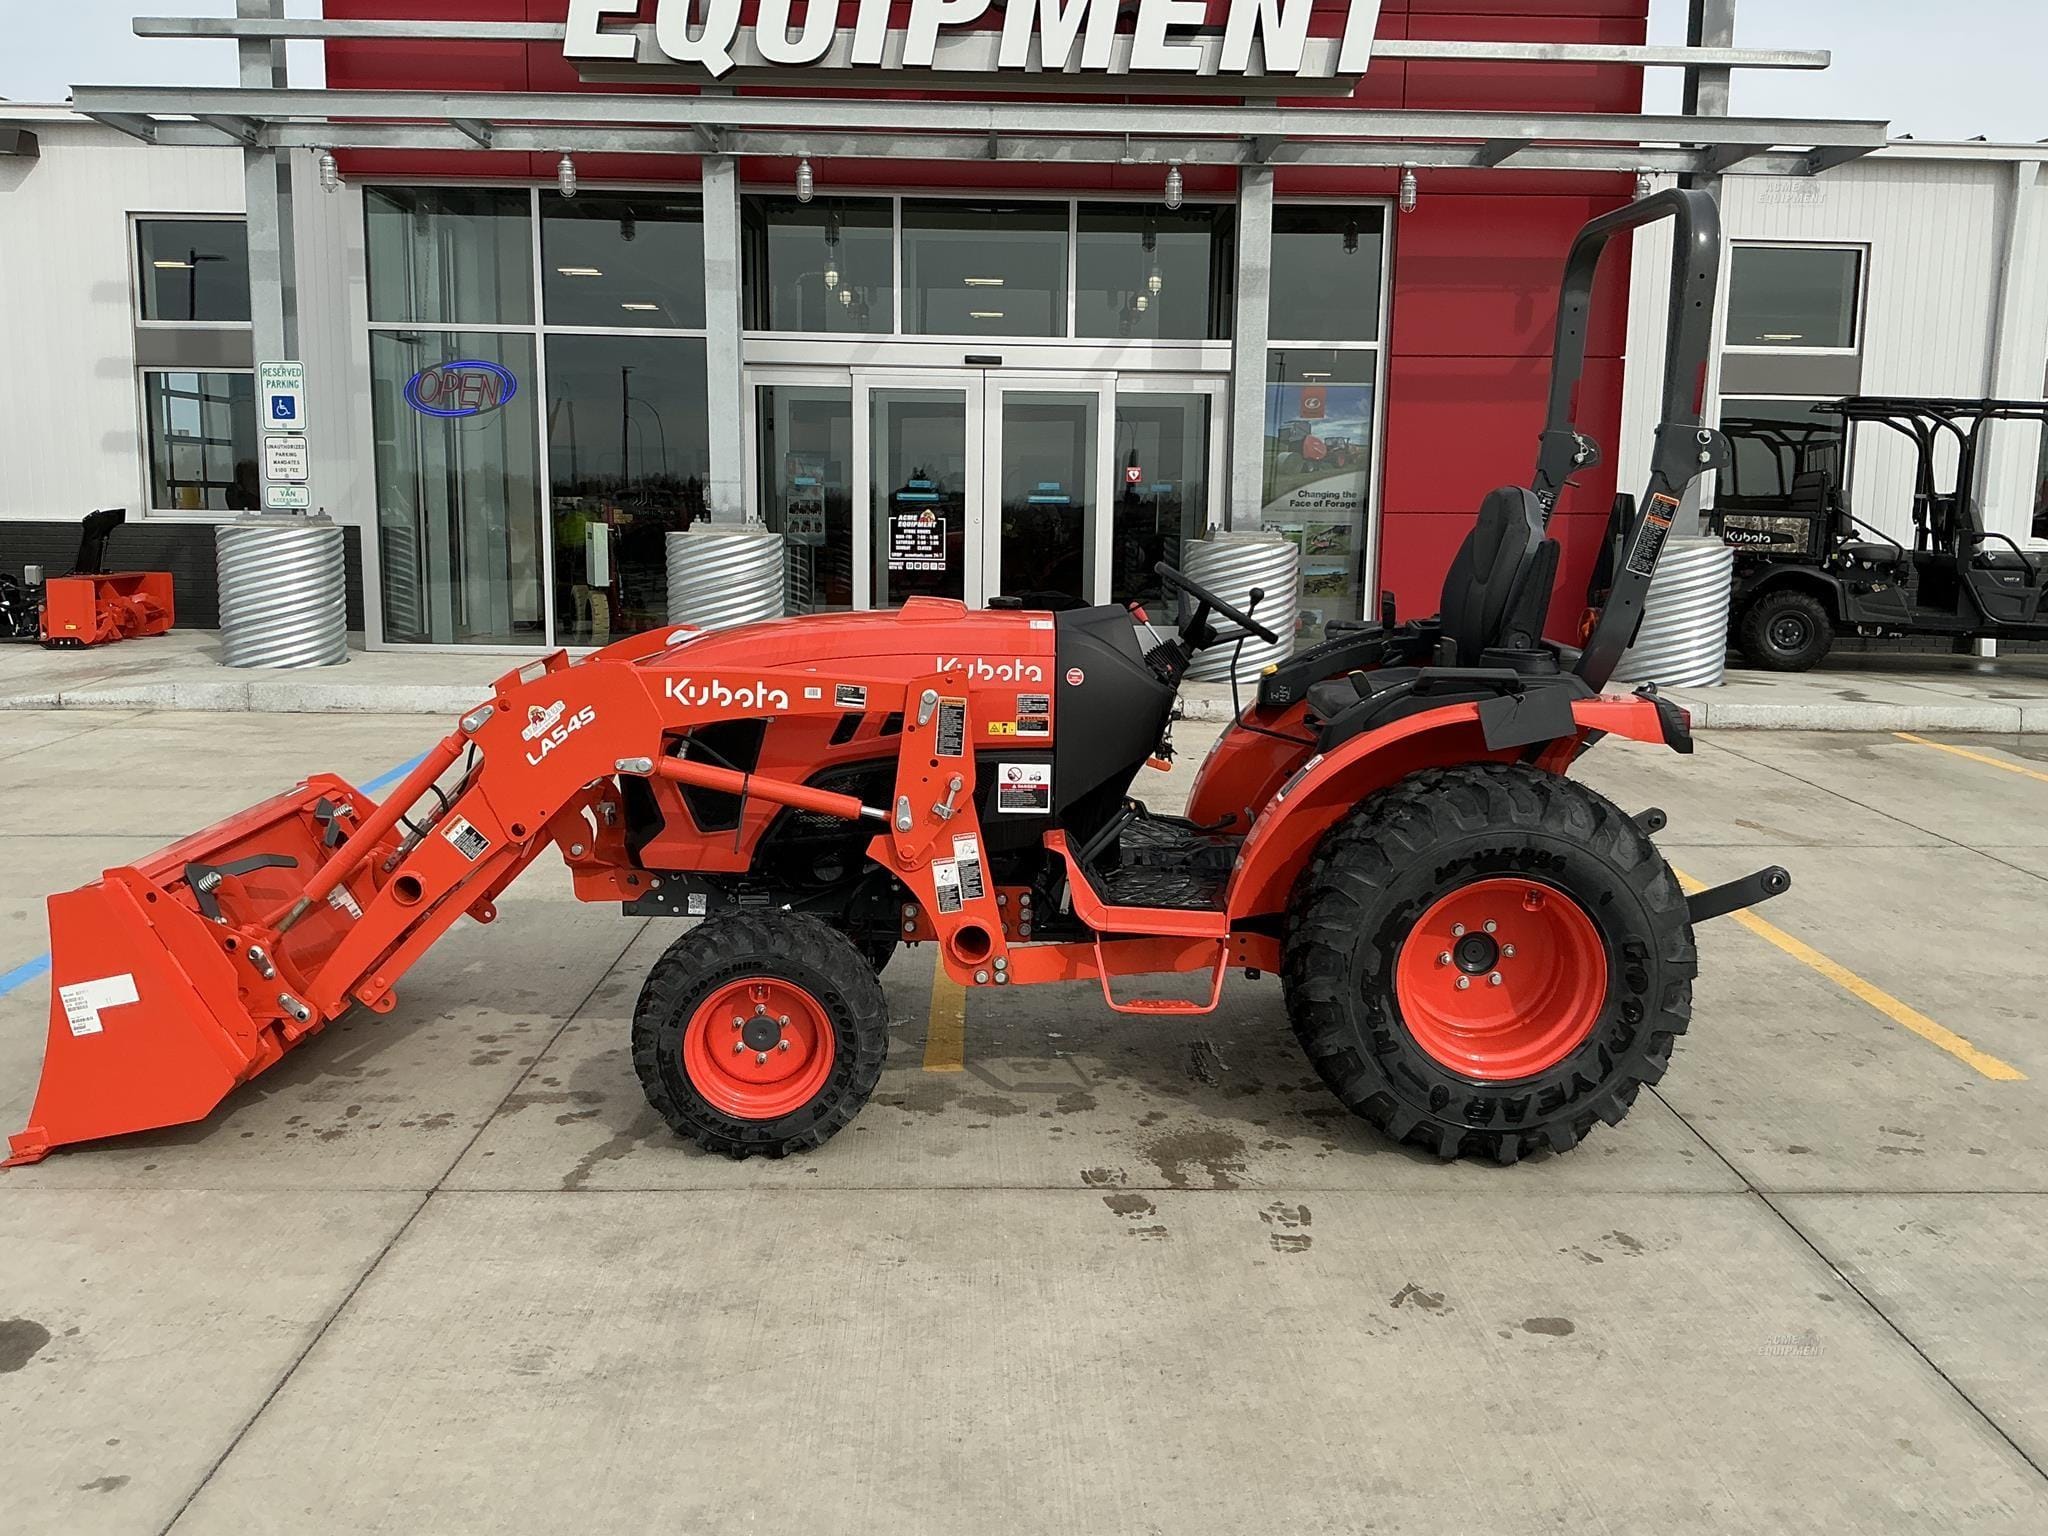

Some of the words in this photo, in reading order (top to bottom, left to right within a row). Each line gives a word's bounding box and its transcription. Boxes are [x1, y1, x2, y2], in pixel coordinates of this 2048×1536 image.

[262, 367, 302, 377] RESERVED
[266, 380, 299, 389] PARKING
[418, 370, 500, 407] OPEN
[1297, 490, 1341, 500] Changing
[1342, 491, 1357, 499] the
[1289, 500, 1312, 508] Face
[1313, 500, 1324, 508] of
[1325, 500, 1357, 509] Forage
[1725, 530, 1771, 544] Kubota
[936, 656, 1043, 682] Kubota
[665, 677, 789, 710] Kubota
[525, 705, 597, 766] LA545
